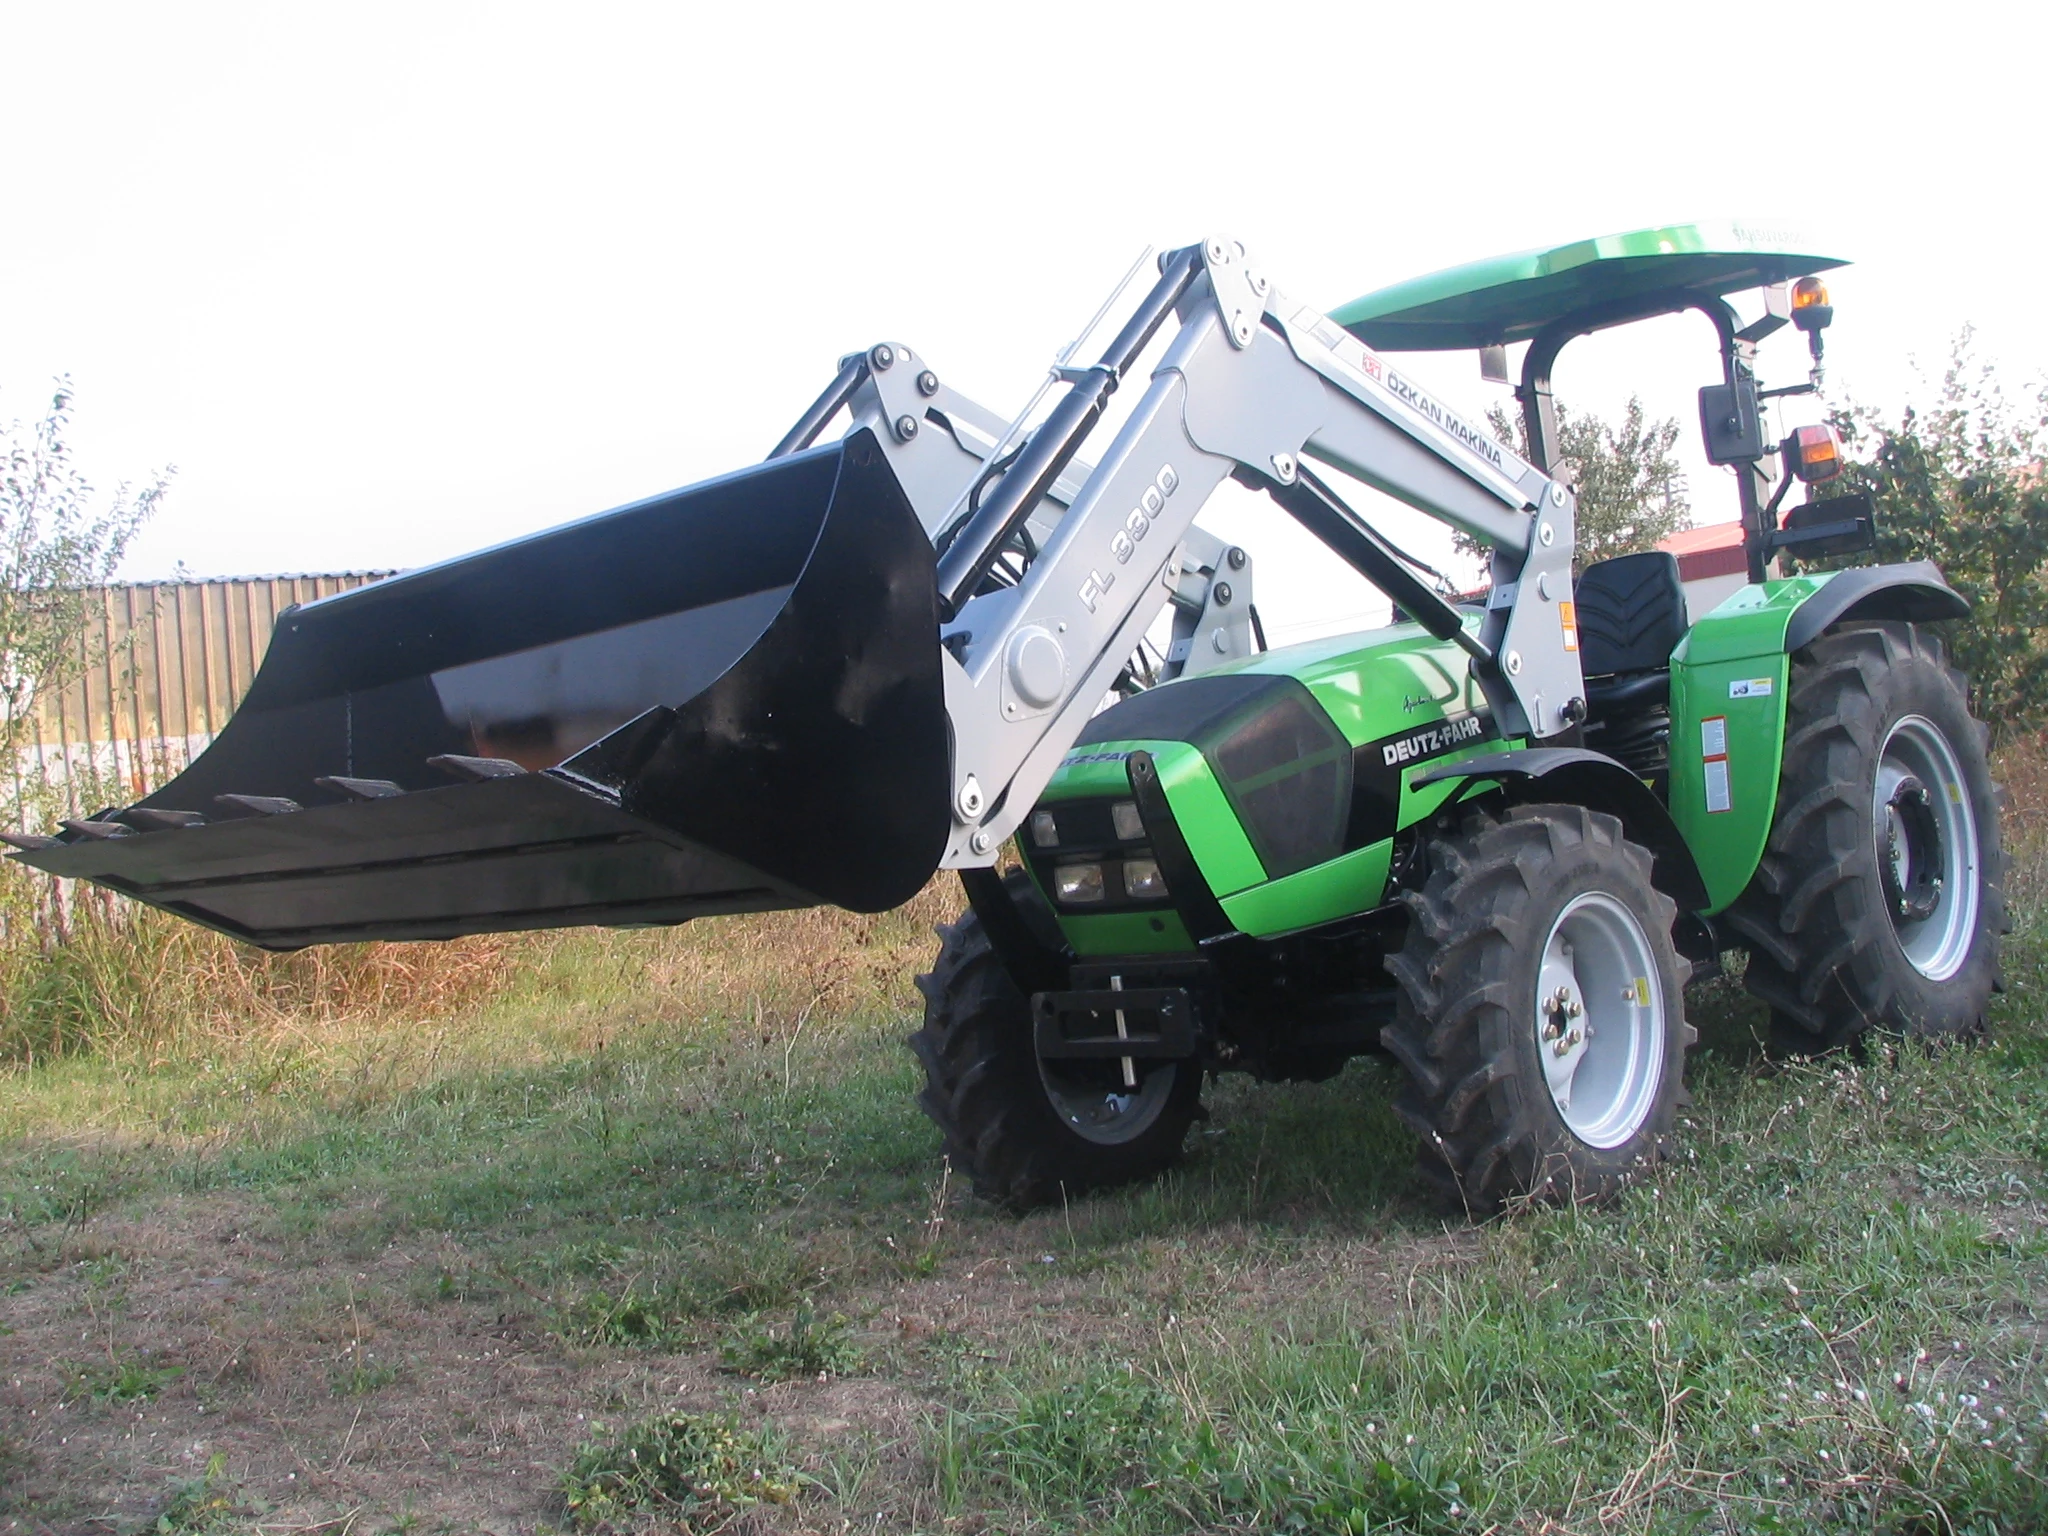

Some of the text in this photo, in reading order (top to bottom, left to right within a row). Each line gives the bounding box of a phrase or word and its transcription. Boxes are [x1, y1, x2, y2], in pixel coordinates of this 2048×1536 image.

[1387, 370, 1502, 468] ÖZKAN MAKİNA
[1077, 463, 1180, 614] FL 3300
[1382, 716, 1482, 766] DEUTZ-FAHR
